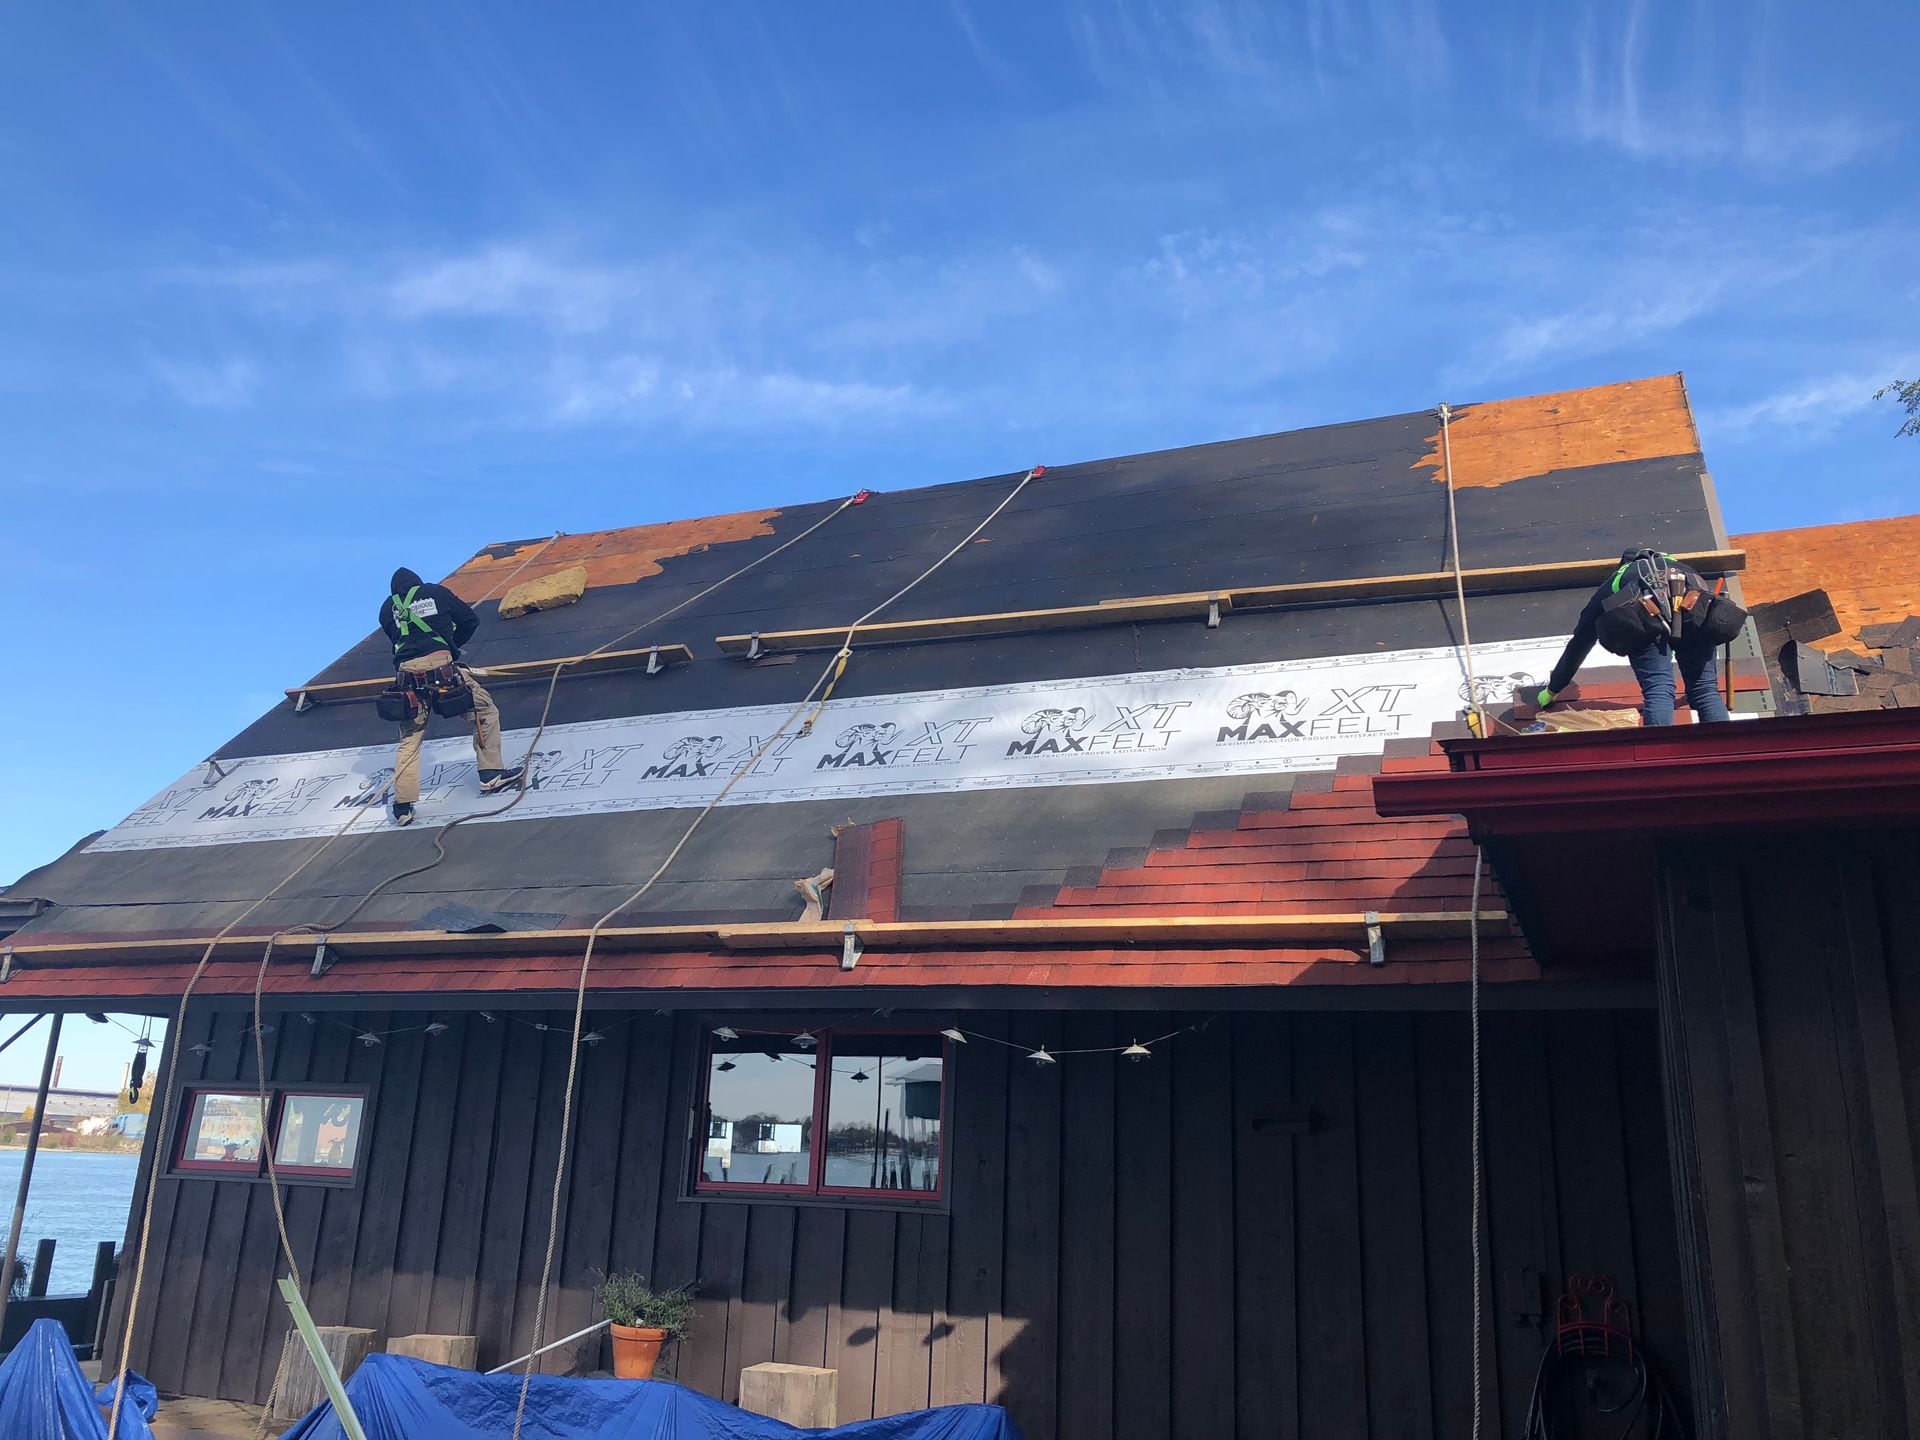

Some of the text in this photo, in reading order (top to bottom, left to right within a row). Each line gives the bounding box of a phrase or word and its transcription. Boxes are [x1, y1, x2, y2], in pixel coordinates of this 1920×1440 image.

[1318, 683, 1418, 716] XT
[1099, 701, 1193, 733] XT
[1216, 713, 1413, 743] MAXFELT
[727, 732, 813, 760] XT
[904, 717, 994, 747] XT
[1005, 729, 1182, 757] MAXFELT
[1259, 737, 1300, 745] TRACTION
[1339, 731, 1400, 739] SATISFACTION
[561, 743, 645, 773] XT
[816, 743, 978, 769] MAXFELT
[1113, 746, 1167, 755] SATISFACTION
[640, 757, 793, 780] MAXFELT
[272, 773, 348, 801] XT
[197, 797, 320, 820] MAXFELT
